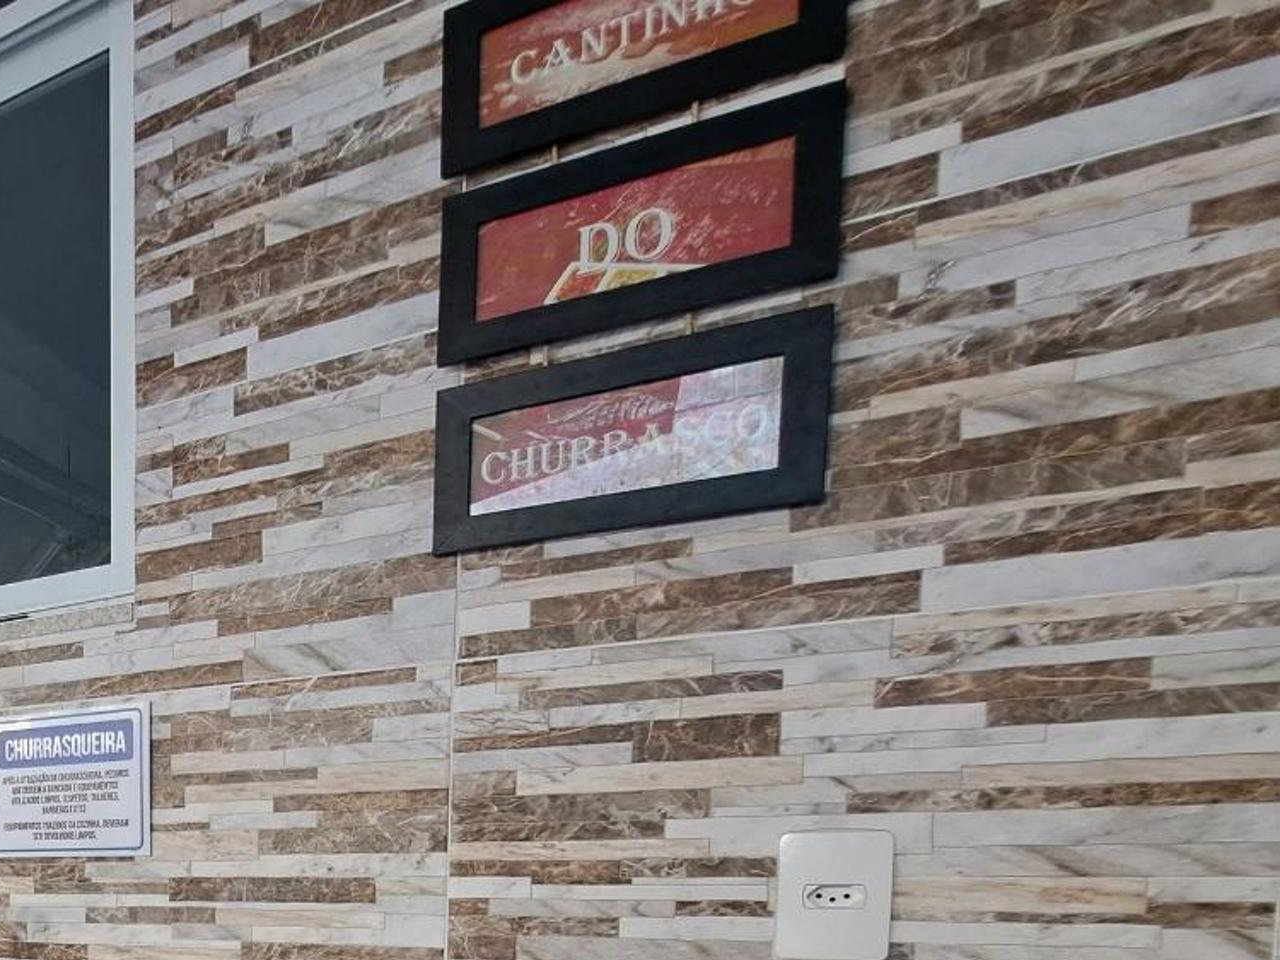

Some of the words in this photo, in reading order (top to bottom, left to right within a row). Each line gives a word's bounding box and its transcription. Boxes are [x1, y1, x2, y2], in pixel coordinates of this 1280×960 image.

[510, 0, 754, 85] CANTINH
[578, 207, 675, 275] DO
[480, 403, 770, 485] CHURRASCO
[5, 730, 126, 762] CHURRASQUEIRA
